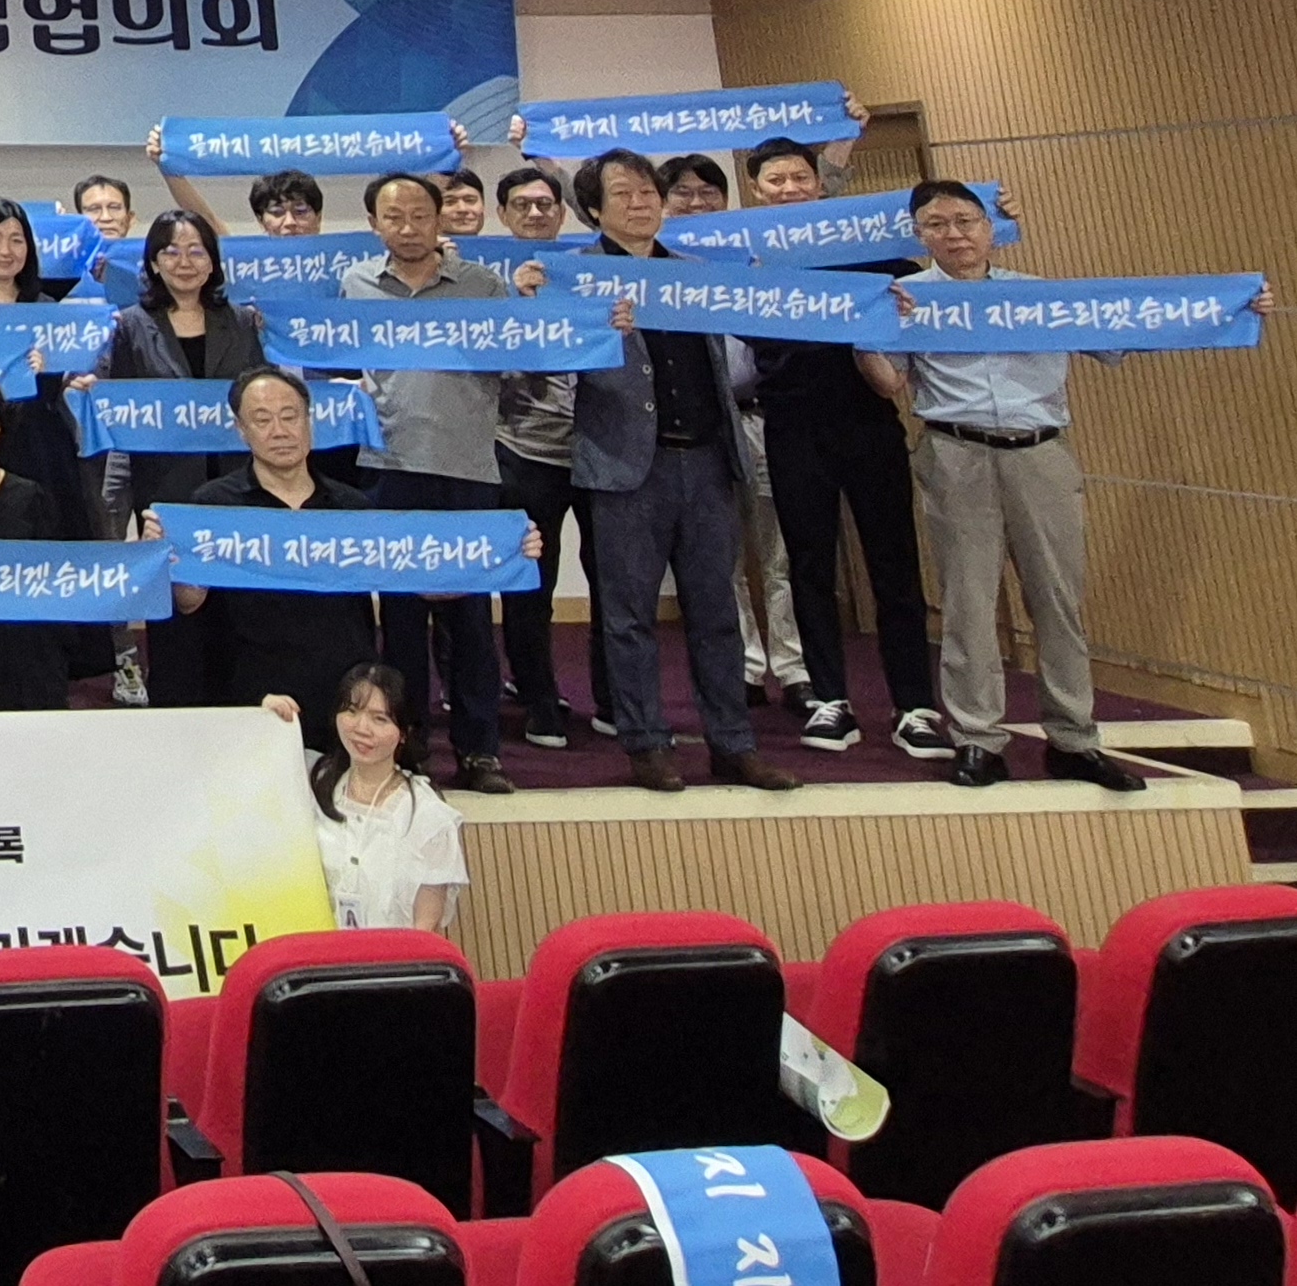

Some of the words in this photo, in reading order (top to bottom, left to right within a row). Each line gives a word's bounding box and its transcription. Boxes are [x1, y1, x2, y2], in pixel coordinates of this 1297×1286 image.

[550, 114, 618, 140] 끝까지
[627, 101, 823, 136] 지켜드리겠습니다.
[189, 133, 251, 158] 끝까지
[259, 130, 431, 158] 지켜드리겠습니다.
[763, 211, 915, 252] 지켜드리겠습
[571, 271, 647, 309] 끝까지
[659, 281, 861, 322] 지켜드리겠습니다.
[985, 296, 1232, 330] 지켜드리겠습니다.
[289, 317, 360, 348] 끝까지
[371, 317, 583, 350] 지켜드리겠습니다.
[95, 398, 163, 429] 끝까지
[192, 529, 271, 566] 끝까지
[283, 534, 501, 571] 지켜드리겠습니다.
